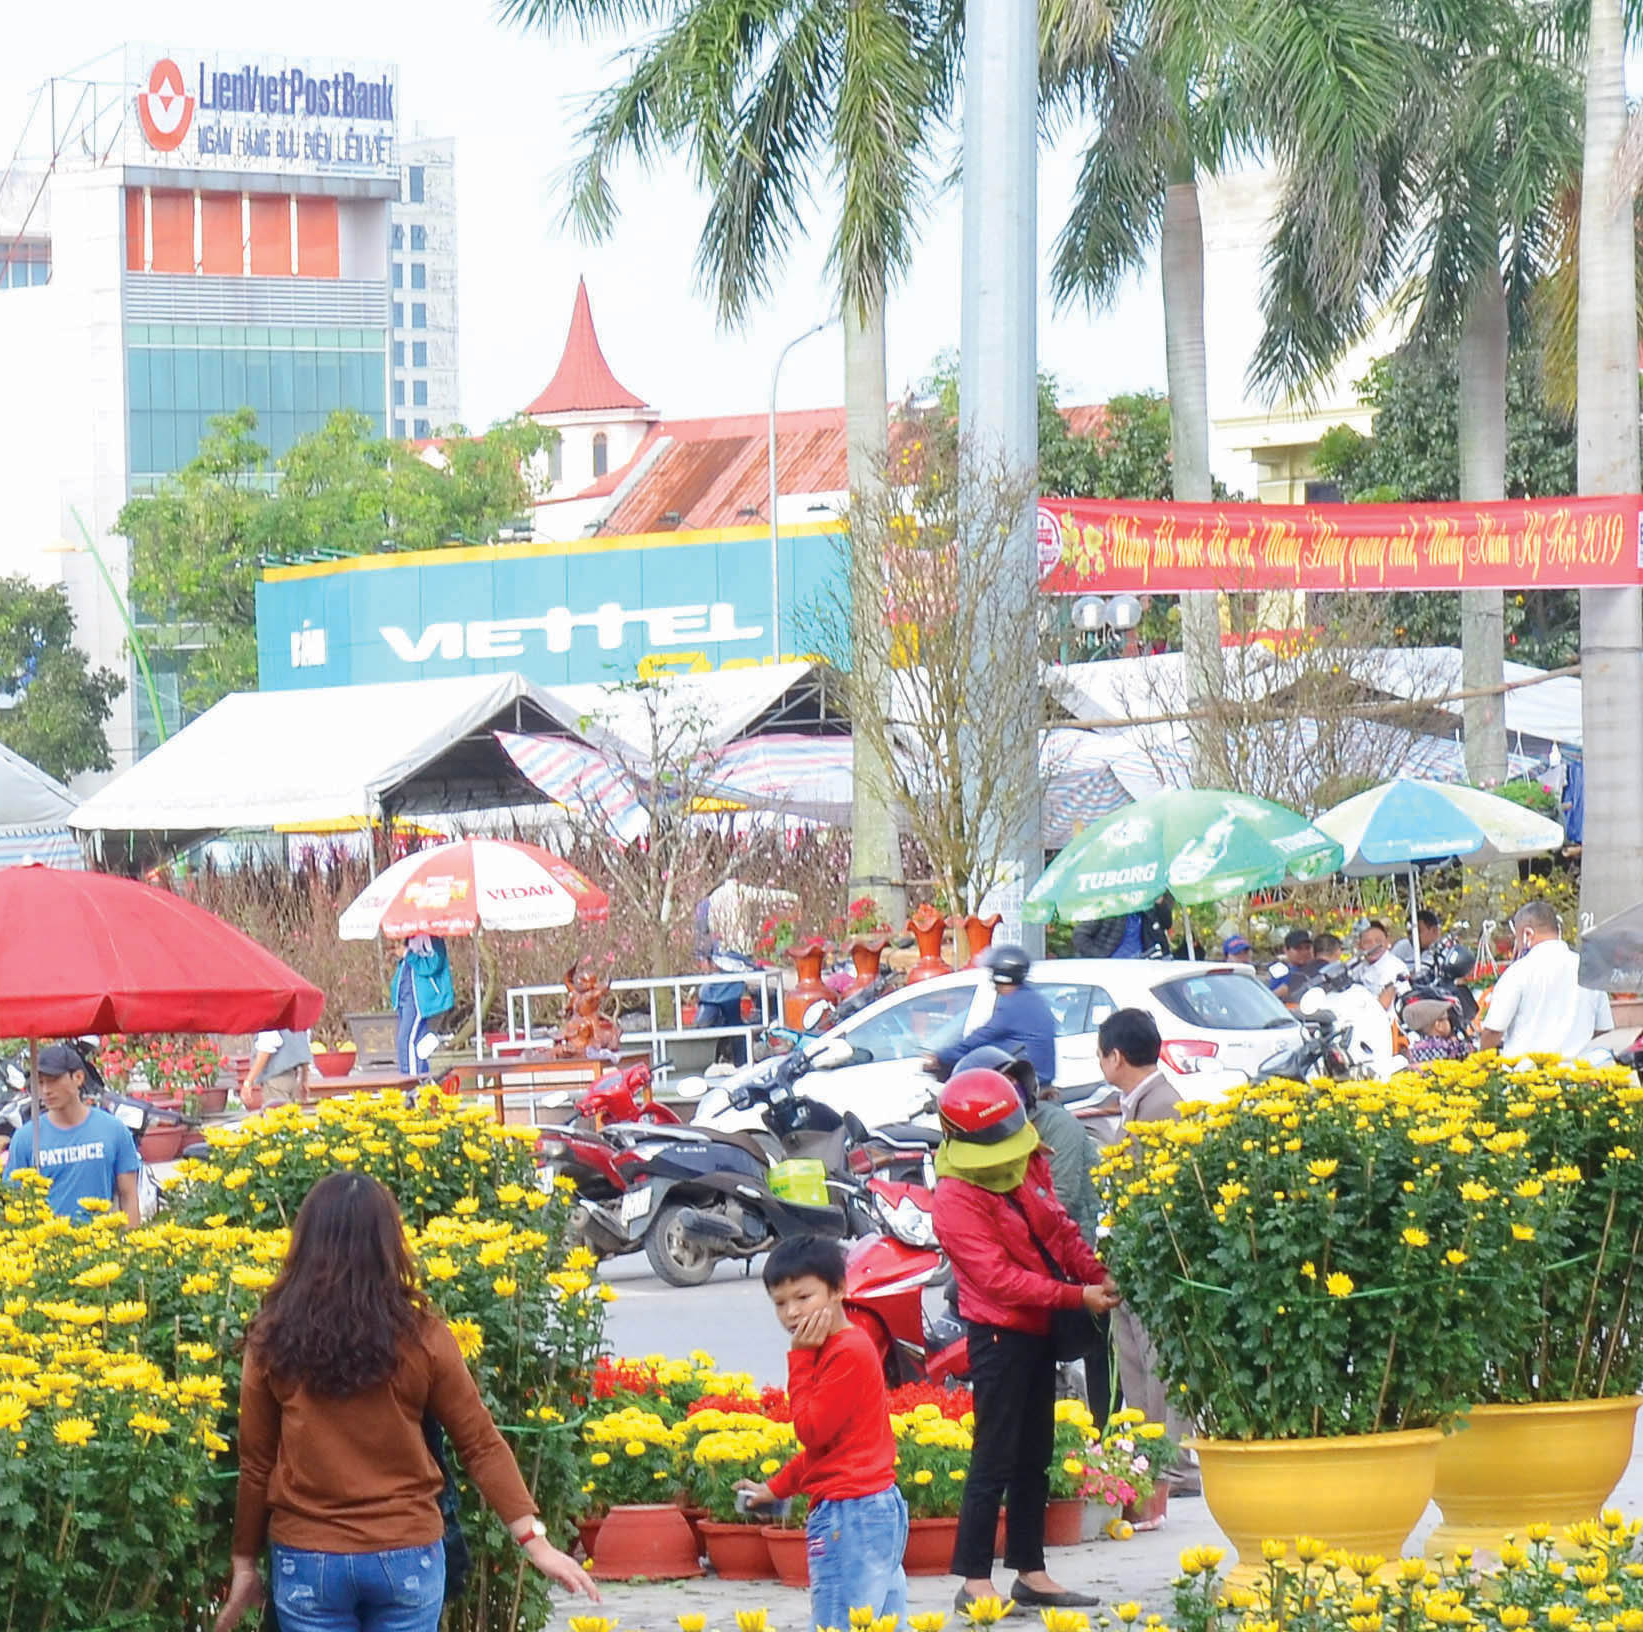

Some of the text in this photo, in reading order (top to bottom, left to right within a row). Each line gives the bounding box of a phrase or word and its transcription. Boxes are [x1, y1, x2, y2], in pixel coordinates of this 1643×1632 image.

[1578, 513, 1624, 566] 2019
[379, 602, 764, 662] VIETTEL
[1076, 861, 1159, 891] TUBORG
[486, 883, 555, 901] VEDAN
[39, 1141, 105, 1168] PATIENCE
